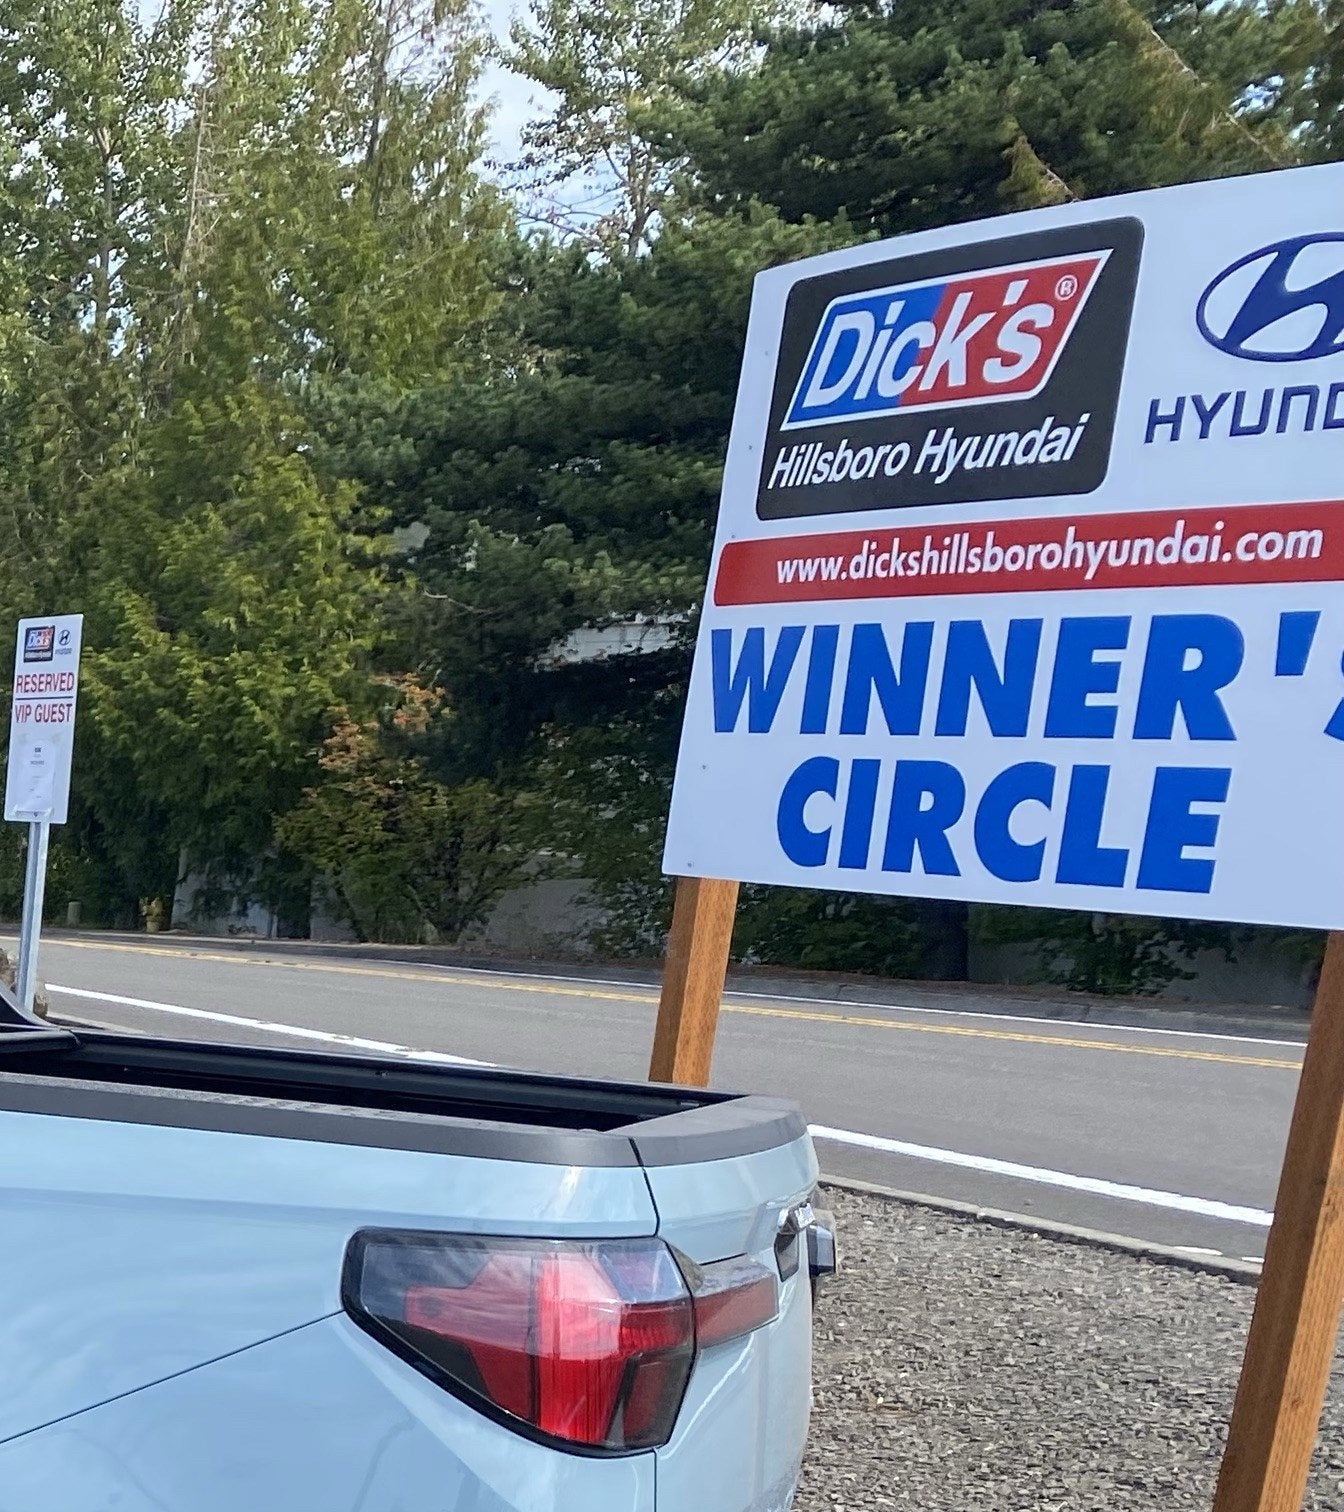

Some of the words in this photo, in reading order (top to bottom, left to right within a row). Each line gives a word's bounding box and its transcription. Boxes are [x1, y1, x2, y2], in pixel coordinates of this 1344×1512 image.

[802, 279, 1055, 409] Dick's
[768, 439, 909, 490] Hillsboro
[915, 415, 1089, 484] Hyundai
[776, 519, 1323, 584] www.dickshillsborohyundai.com
[15, 704, 32, 723] VIP
[35, 703, 73, 723] GUEST
[16, 671, 74, 693] RESERVED
[710, 610, 1344, 741] WINNER'
[776, 756, 1232, 893] CIRCLE
